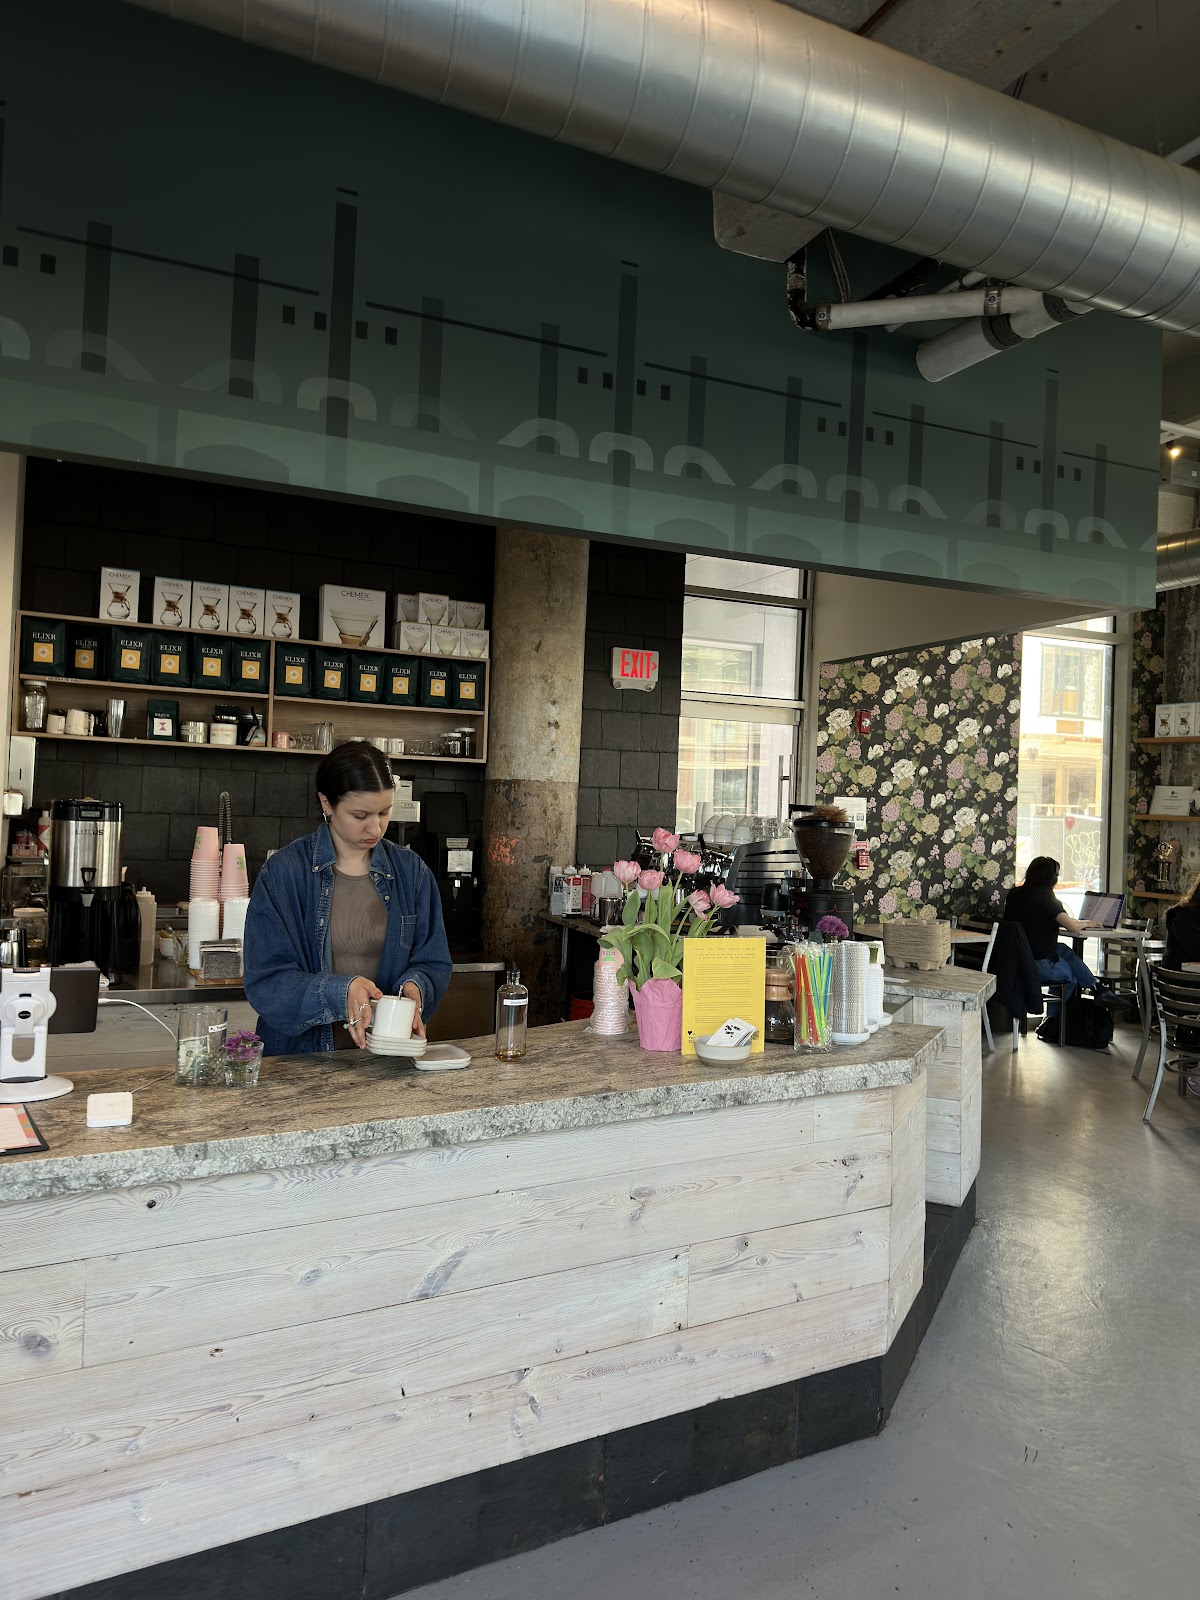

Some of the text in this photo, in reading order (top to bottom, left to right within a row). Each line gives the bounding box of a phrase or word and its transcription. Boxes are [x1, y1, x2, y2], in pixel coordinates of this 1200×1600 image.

[341, 590, 370, 599] CHEMEX
[32, 632, 57, 640] ELIXR
[75, 639, 98, 648] ELIXR
[120, 639, 144, 648] ELIXR
[160, 644, 182, 652] ELIXR
[201, 647, 224, 655] ELIXR
[240, 650, 262, 659] ELIXR
[284, 655, 306, 664] ELIXR
[323, 660, 344, 669] ELIXR
[359, 664, 379, 672] ELIXR
[620, 650, 653, 679] EXIT
